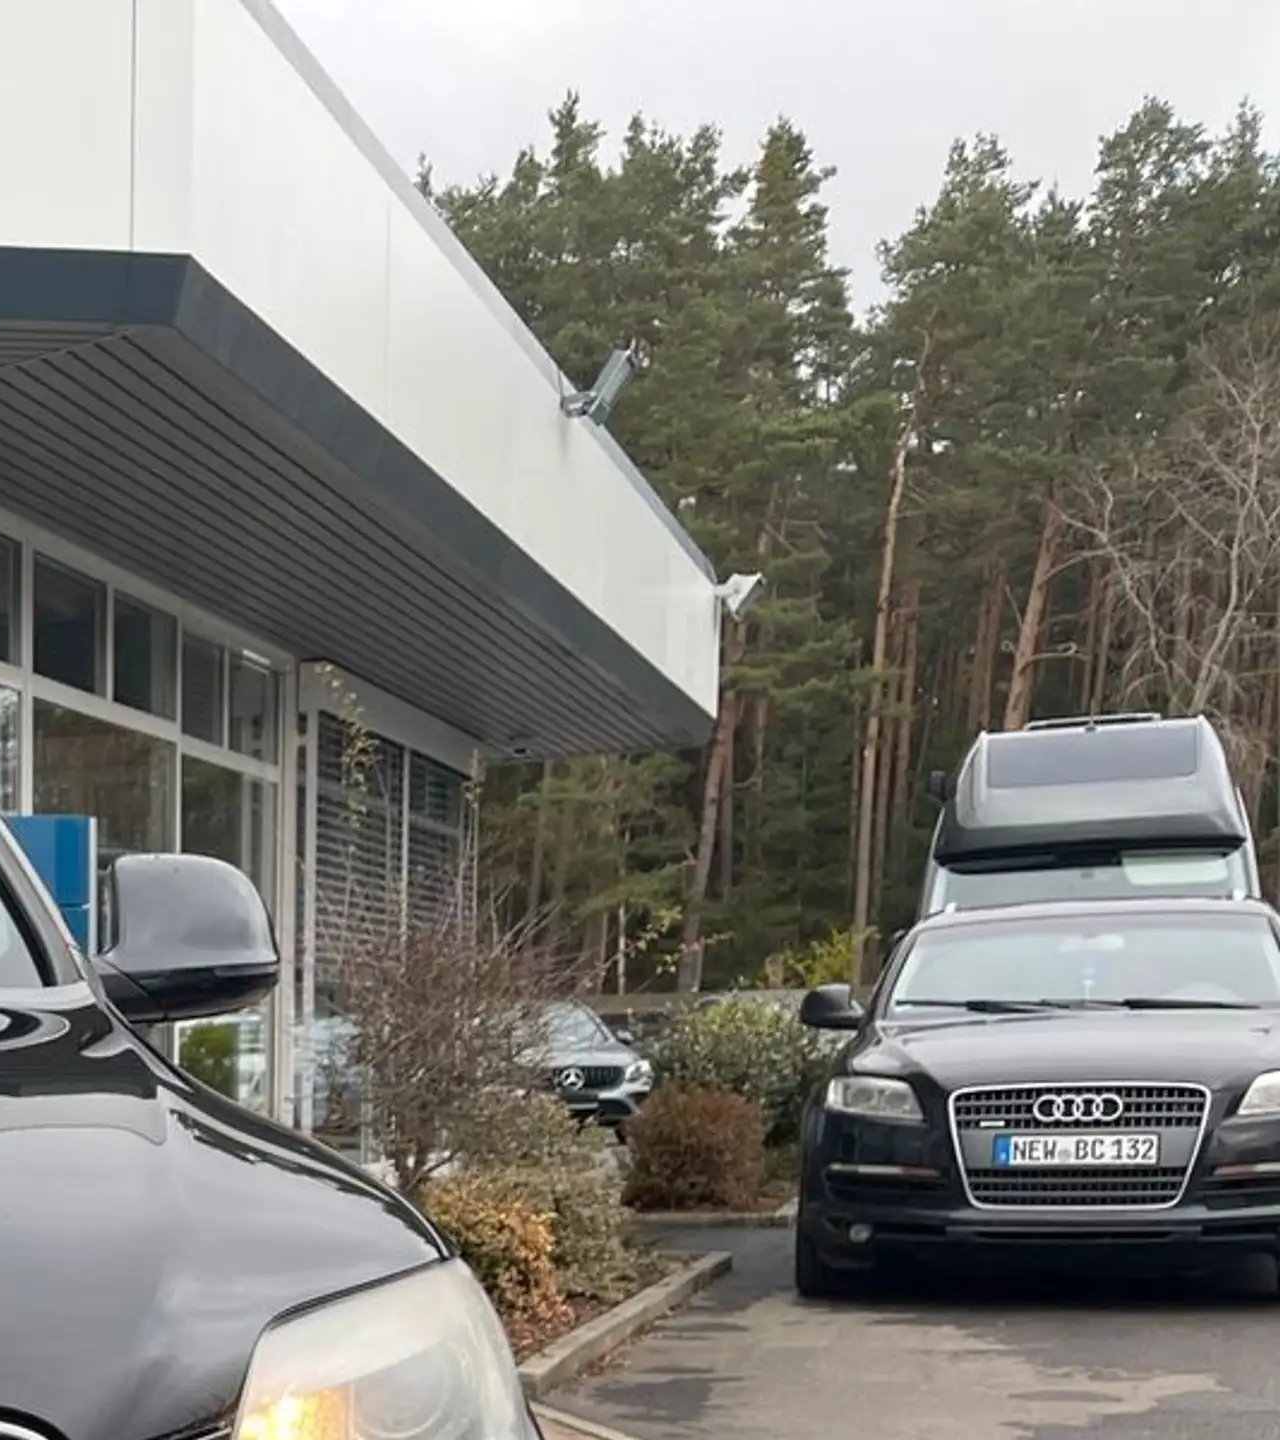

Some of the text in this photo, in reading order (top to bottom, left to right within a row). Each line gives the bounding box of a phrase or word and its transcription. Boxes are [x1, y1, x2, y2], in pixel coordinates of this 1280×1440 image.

[1013, 1138, 1154, 1161] NEW BC 132
